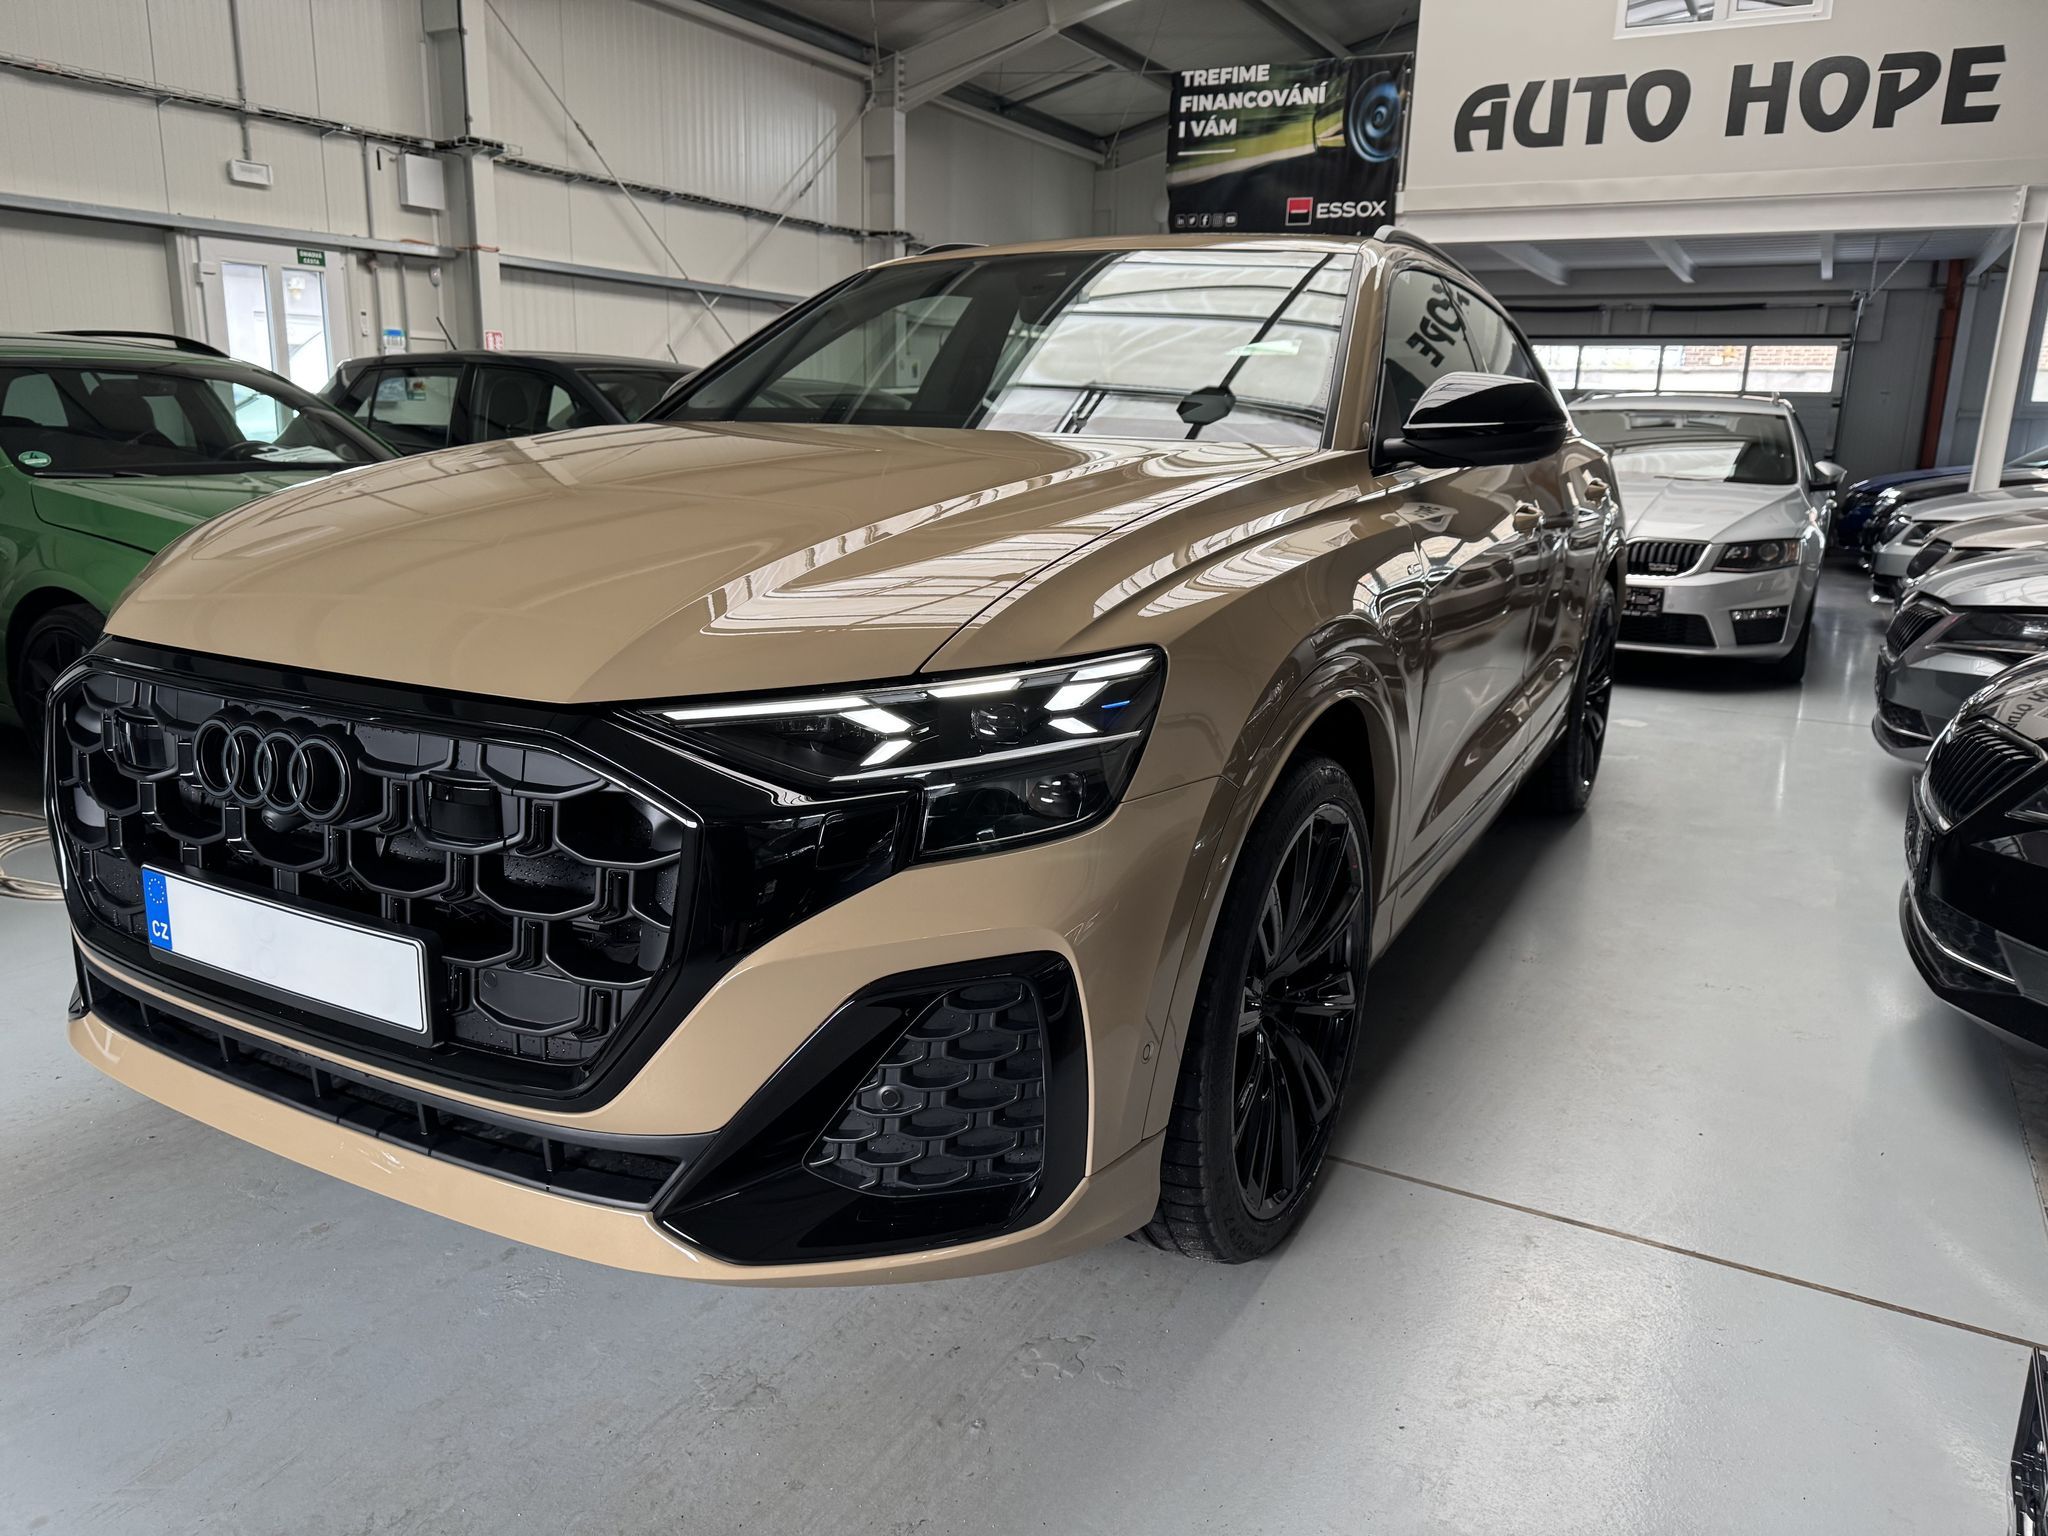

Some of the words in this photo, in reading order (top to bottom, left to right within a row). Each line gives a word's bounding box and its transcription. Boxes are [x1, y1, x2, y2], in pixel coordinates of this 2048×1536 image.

[1180, 64, 1271, 88] TREFIME
[1179, 81, 1329, 113] FINANCOVÁNÍ
[1453, 69, 1693, 152] AUTO
[1724, 45, 2007, 137] HOPE
[1178, 121, 1186, 138] I
[1190, 114, 1238, 138] VÁM
[1315, 200, 1388, 220] ESSOX
[152, 919, 170, 940] CZ
